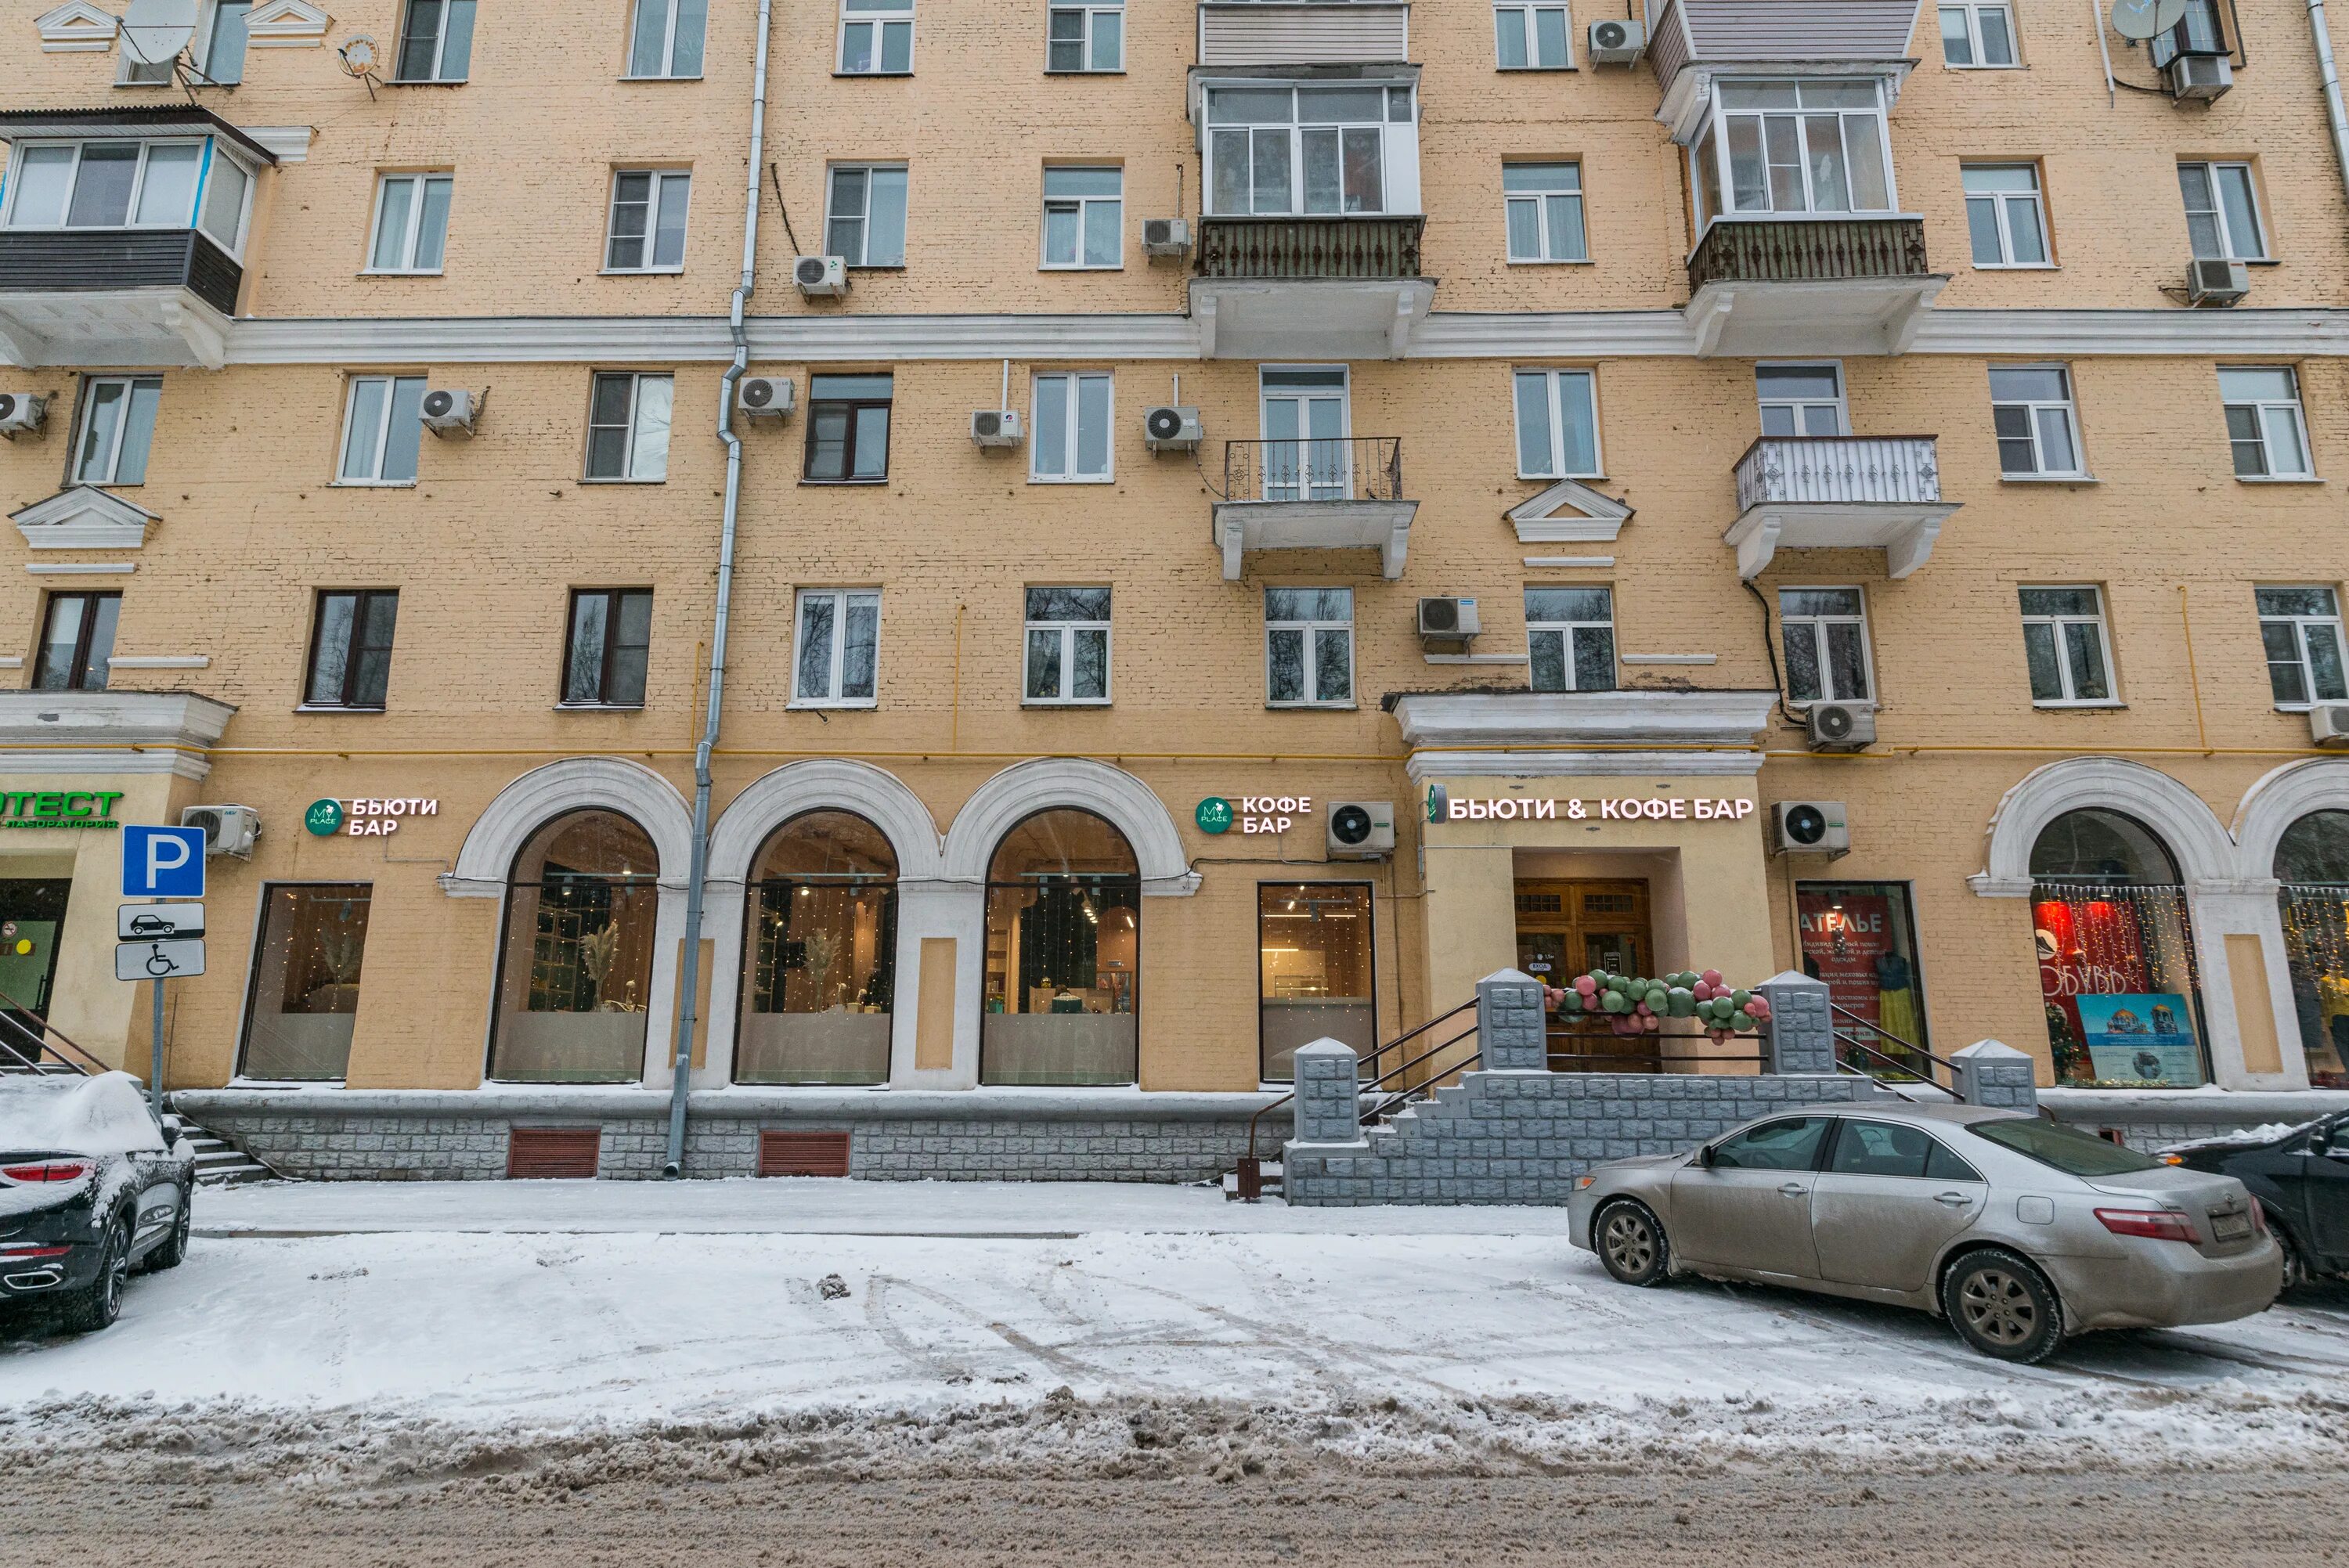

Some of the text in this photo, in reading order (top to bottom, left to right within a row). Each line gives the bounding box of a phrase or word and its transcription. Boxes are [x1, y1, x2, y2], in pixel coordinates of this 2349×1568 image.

[0, 791, 124, 816] ТЕСТ
[352, 799, 438, 816] БЬЮТИ
[1243, 797, 1312, 813] КОФЕ
[1449, 798, 1556, 819] БЬЮТИ
[1568, 798, 1587, 819] &
[1601, 798, 1687, 819] КОФЕ
[1694, 798, 1754, 819] БАР
[5, 820, 119, 828] ЛАБОРАТОРИЯ
[348, 820, 398, 835] БАР
[1243, 817, 1291, 834] БАР
[146, 834, 190, 889] P
[1800, 912, 1882, 932] АТЕЛЬЕ
